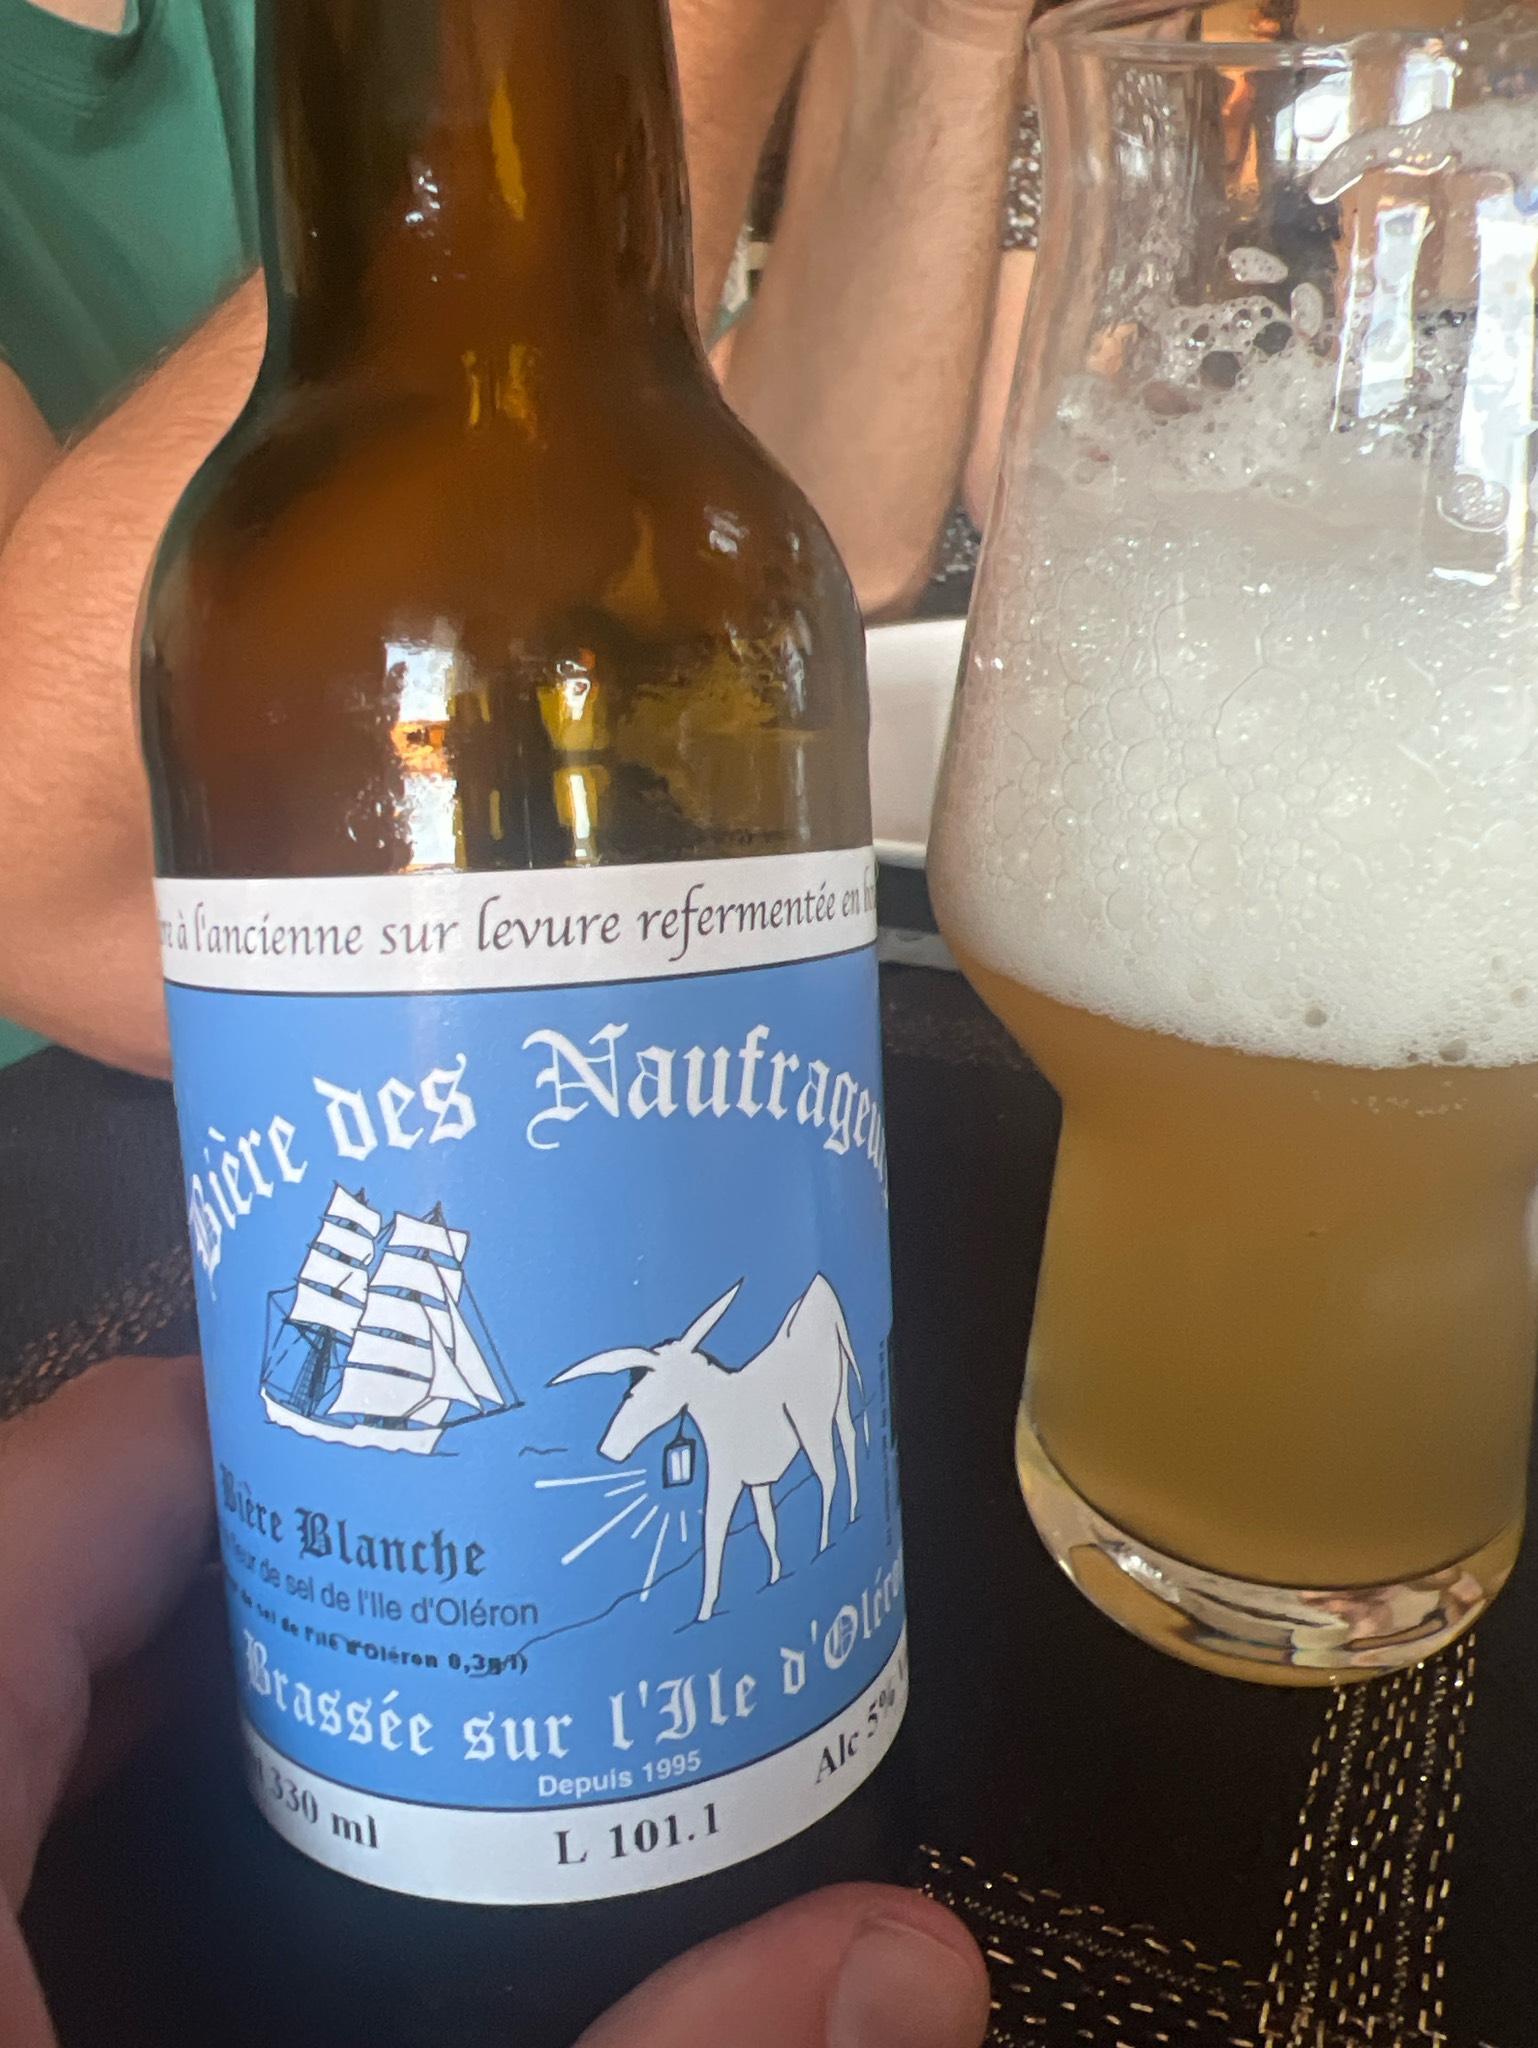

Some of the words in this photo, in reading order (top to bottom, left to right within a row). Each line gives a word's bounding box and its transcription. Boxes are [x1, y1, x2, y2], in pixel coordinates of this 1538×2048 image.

[177, 908, 188, 951] à
[194, 900, 363, 956] l'ancienne
[380, 921, 459, 955] sur
[477, 894, 621, 951] levure
[636, 881, 836, 962] refermentée
[842, 888, 860, 918] en
[312, 1052, 477, 1162] des
[295, 1506, 486, 1583] Blanche
[260, 1557, 280, 1589] de
[286, 1574, 314, 1603] sel
[321, 1581, 350, 1613] de
[411, 1596, 539, 1628] d'Oléron
[243, 1628, 434, 1757] Brassée
[463, 1710, 573, 1761] sur
[538, 1764, 633, 1799] Depuis
[641, 1748, 702, 1784] 1995
[814, 1731, 860, 1785] Alc
[269, 1765, 319, 1824] 330
[329, 1811, 379, 1849] ml
[553, 1828, 588, 1866] L
[608, 1801, 720, 1859] 101.1
